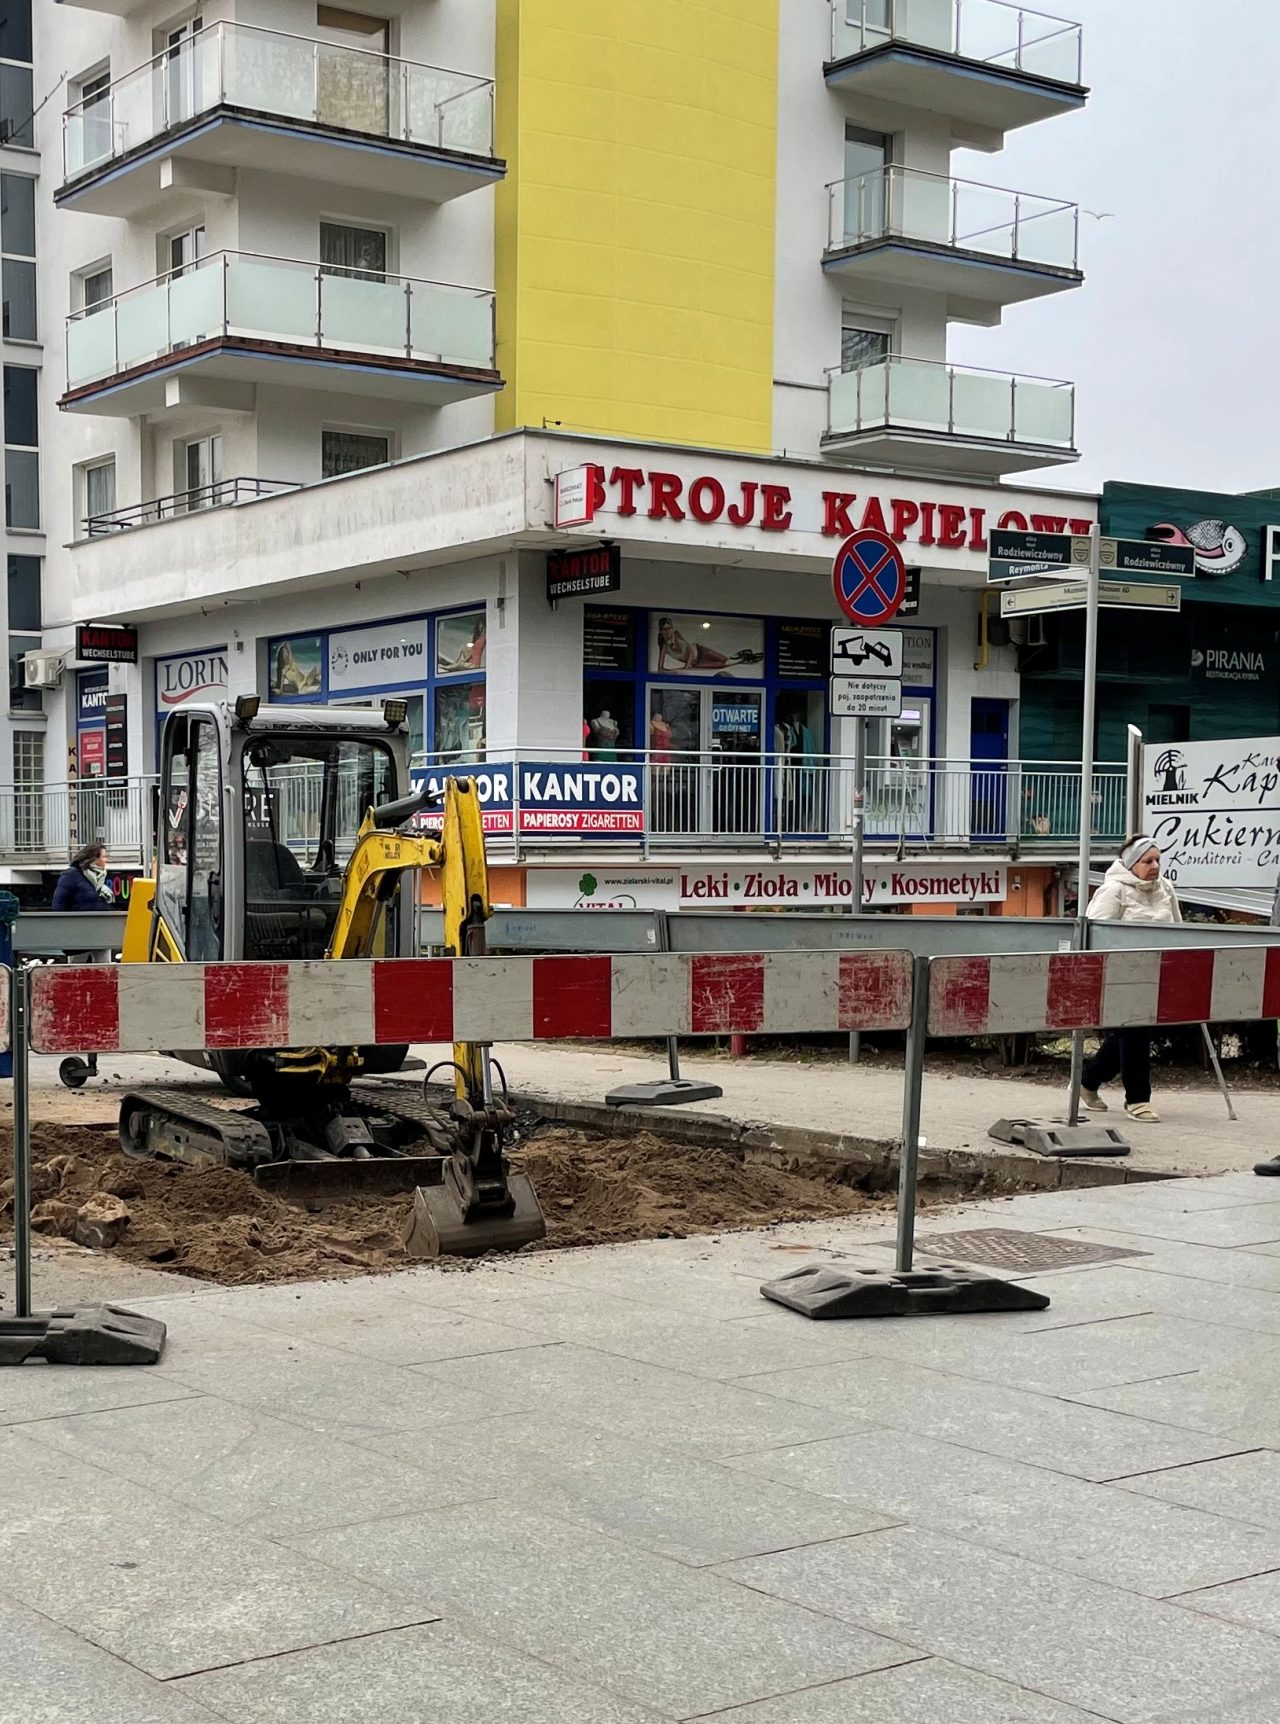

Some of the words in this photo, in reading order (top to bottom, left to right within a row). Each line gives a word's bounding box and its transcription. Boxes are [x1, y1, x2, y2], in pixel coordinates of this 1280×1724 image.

[997, 546, 1063, 562] Rodziewiczówny
[1123, 557, 1186, 572] Rodziewiczówny
[550, 575, 610, 595] WECHSELSTUBE
[82, 648, 135, 659] WECHSELSTUBE
[353, 649, 378, 664] ONLY
[381, 646, 399, 660] FOR
[402, 643, 423, 657] YOU
[1206, 650, 1265, 671] PIRANIA
[848, 682, 860, 690] Nie
[862, 682, 886, 692] dotyczy
[838, 693, 851, 702] poj.
[853, 694, 896, 702] zaopatrzenia
[712, 708, 758, 724] OTWARTE
[524, 772, 638, 802] KANTOR
[1145, 792, 1199, 806] MIELNIK
[523, 813, 581, 828] PAPIEROSY
[581, 813, 640, 829] ZIGARETTEN
[1168, 850, 1242, 867] Konditorei
[604, 876, 674, 886] www.zielarski-vital.pl
[680, 873, 728, 898] Leki
[744, 873, 798, 898] Zioła
[814, 873, 877, 902] Mioy
[891, 870, 1000, 901] Kosmetyki
